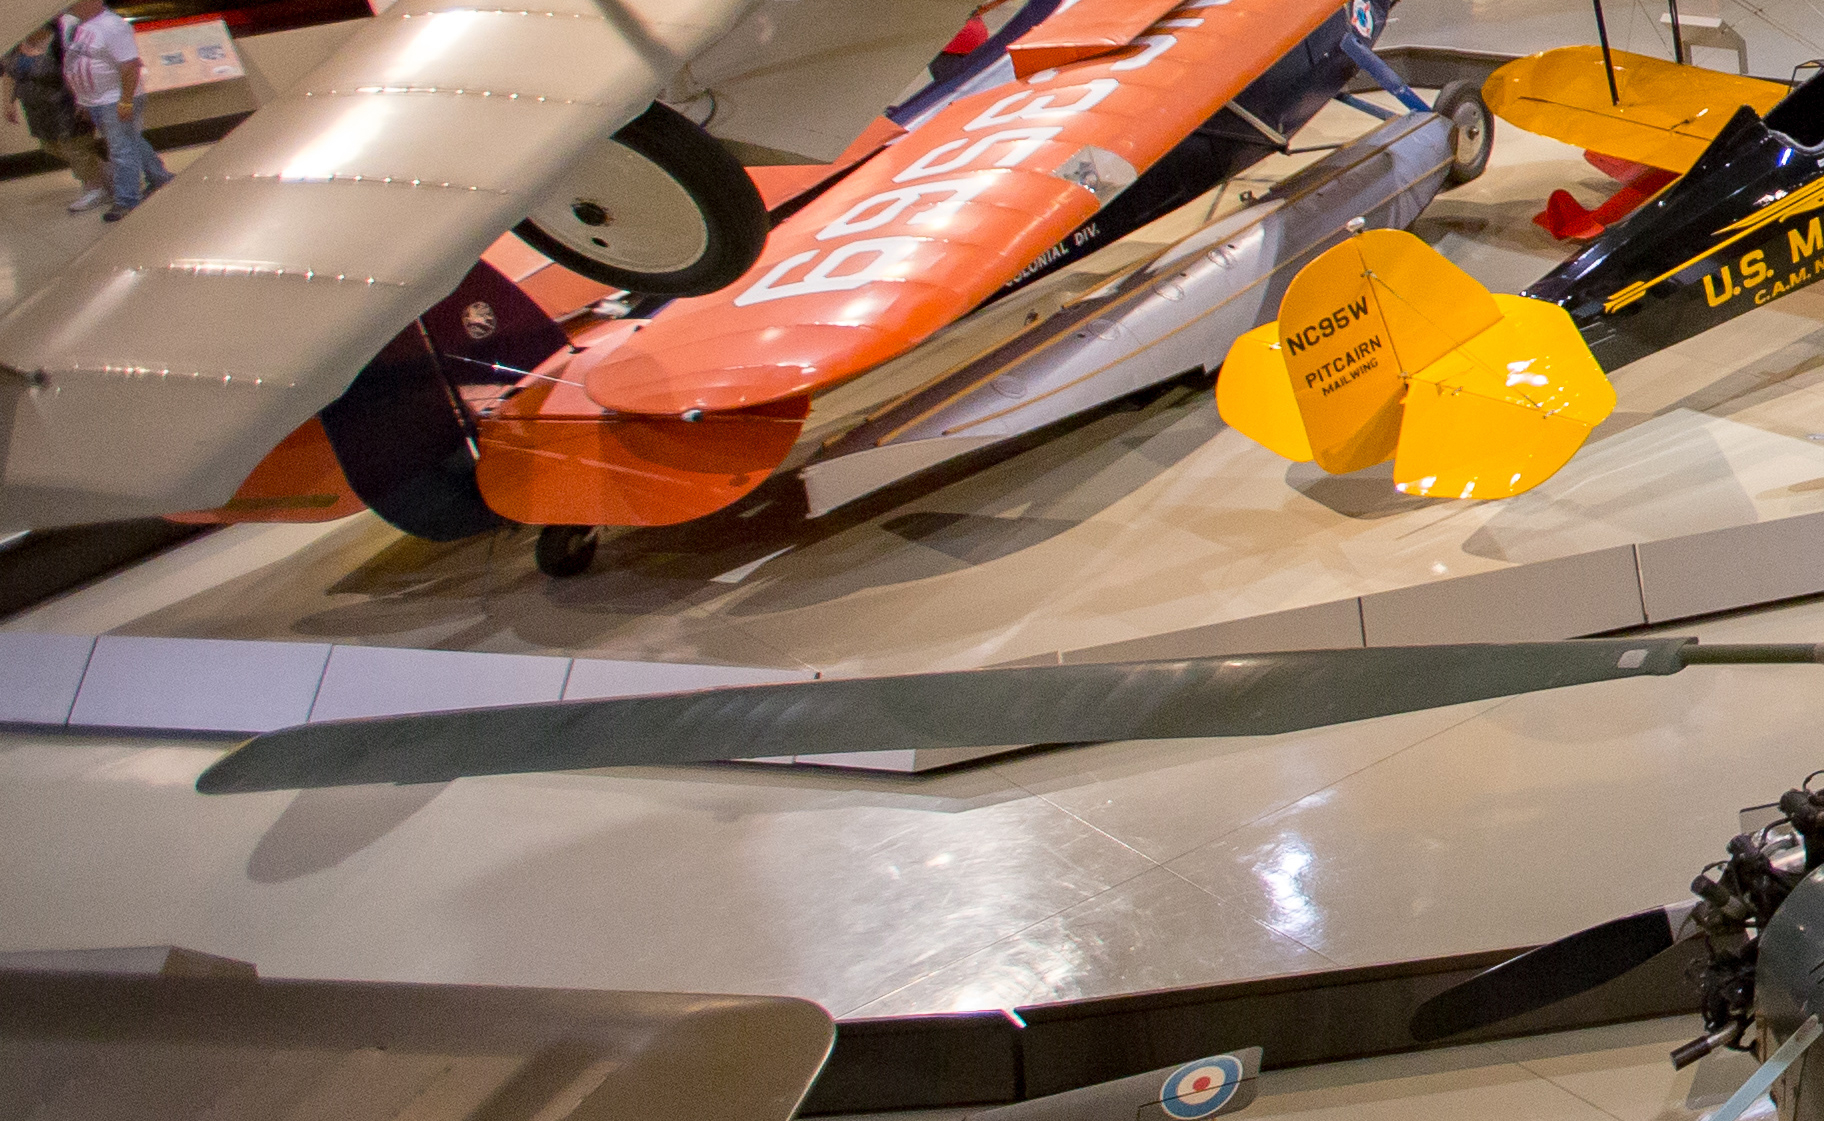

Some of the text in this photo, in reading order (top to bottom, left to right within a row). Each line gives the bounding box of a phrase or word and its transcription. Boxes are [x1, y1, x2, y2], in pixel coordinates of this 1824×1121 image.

[1073, 222, 1102, 248] DIV.
[1703, 248, 1775, 308] U.S.
[1753, 267, 1812, 306] C.A.M.
[1286, 295, 1369, 357] NC95W
[1305, 334, 1383, 389] PITCAIRN
[1321, 357, 1379, 397] MAILWING
